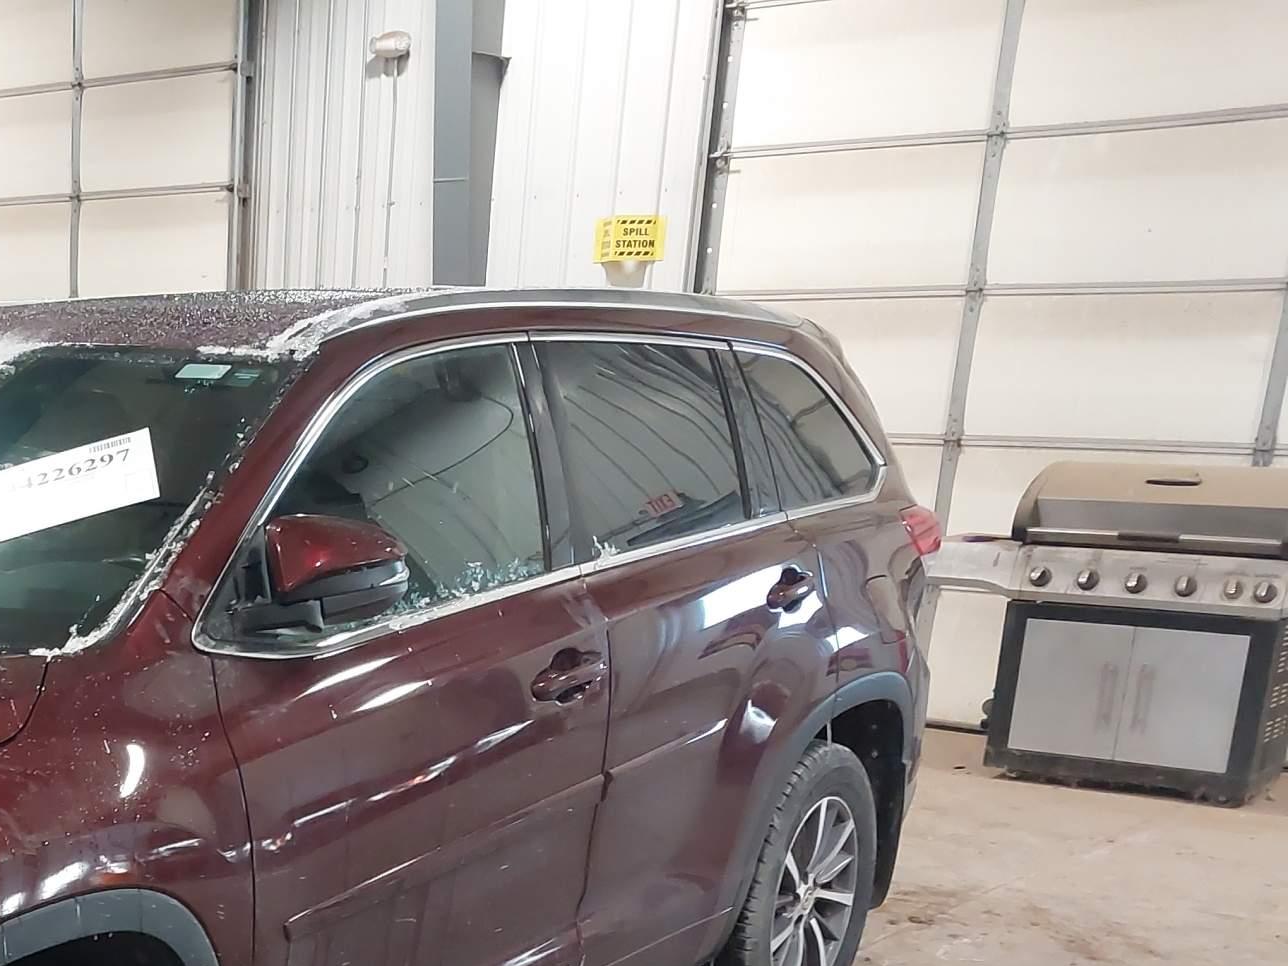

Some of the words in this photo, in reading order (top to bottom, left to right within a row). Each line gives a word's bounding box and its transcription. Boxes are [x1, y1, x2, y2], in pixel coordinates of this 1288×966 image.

[623, 227, 649, 236] SPILL
[615, 239, 655, 248] STATION
[10, 448, 130, 491] 4226297
